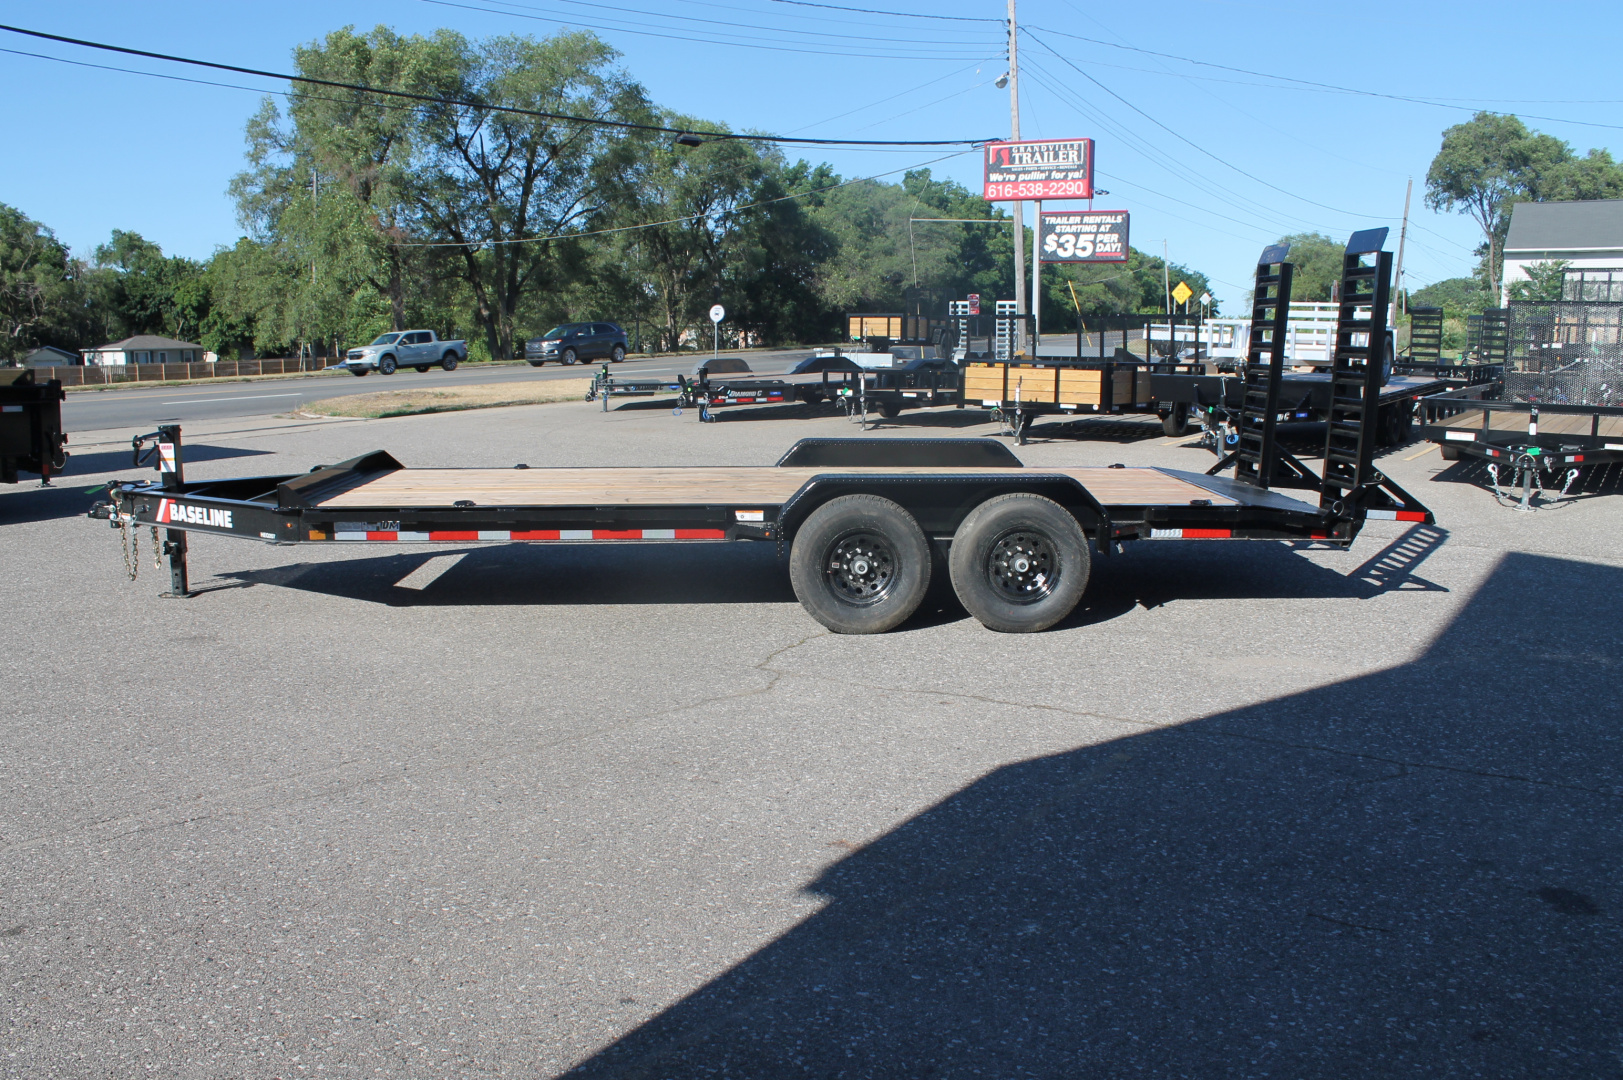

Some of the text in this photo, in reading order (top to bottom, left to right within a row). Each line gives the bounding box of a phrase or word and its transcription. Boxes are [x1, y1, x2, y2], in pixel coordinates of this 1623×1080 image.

[1012, 143, 1079, 153] GRANDVILLE
[1011, 150, 1079, 165] TRAILER
[989, 169, 1084, 182] We're pullin' for ya!
[988, 182, 1083, 197] 616-538-2290
[1045, 215, 1122, 224] TRAILER RENTALS
[1055, 224, 1112, 233] STARTING AT
[1096, 233, 1119, 243] PER
[1044, 232, 1095, 258] $35
[1096, 242, 1122, 252] DAY!
[169, 504, 233, 528] BASELINE
